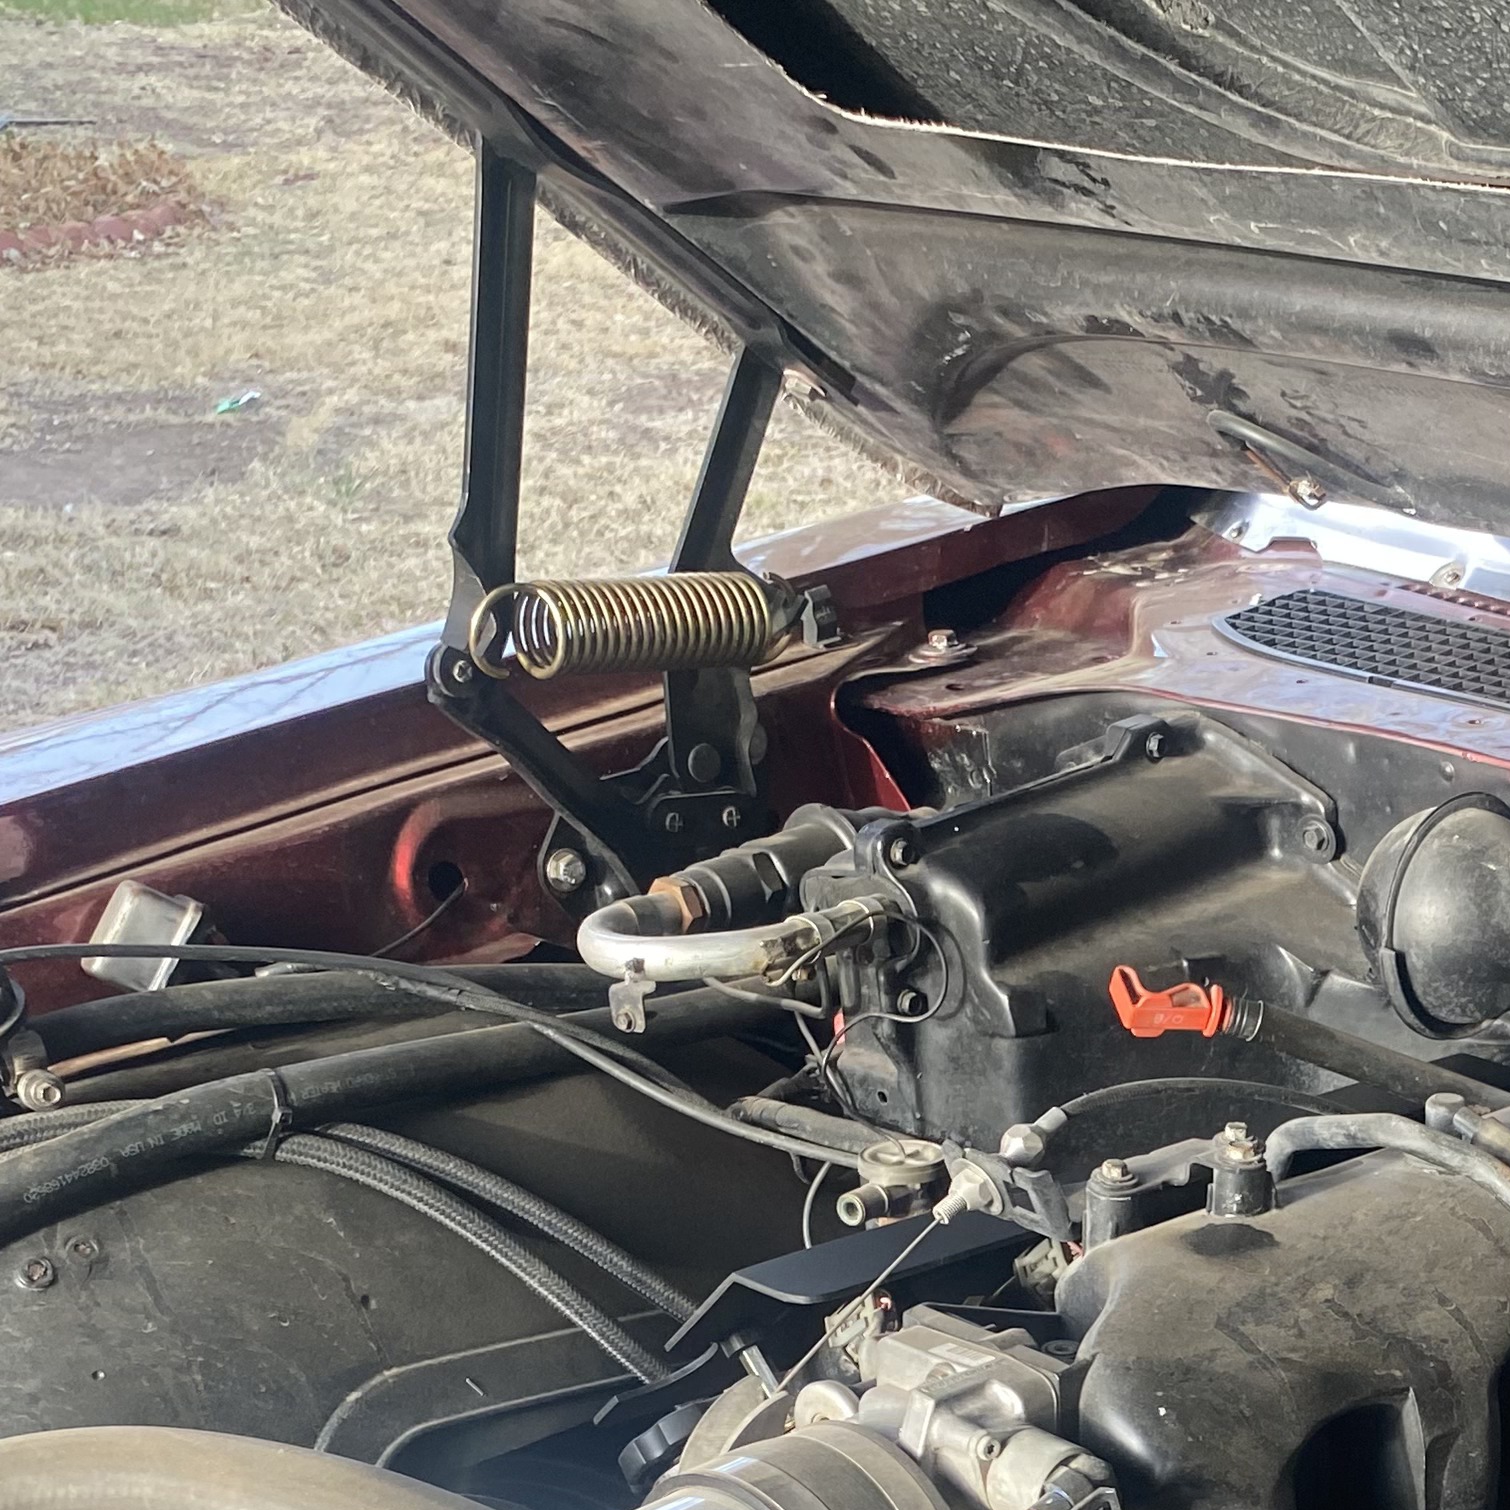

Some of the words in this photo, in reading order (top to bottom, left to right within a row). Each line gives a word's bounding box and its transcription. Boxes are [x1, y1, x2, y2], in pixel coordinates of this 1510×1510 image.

[213, 1111, 229, 1126] ID
[170, 1122, 202, 1141] MADE
[148, 1134, 165, 1148] IN
[120, 1141, 145, 1158] USA
